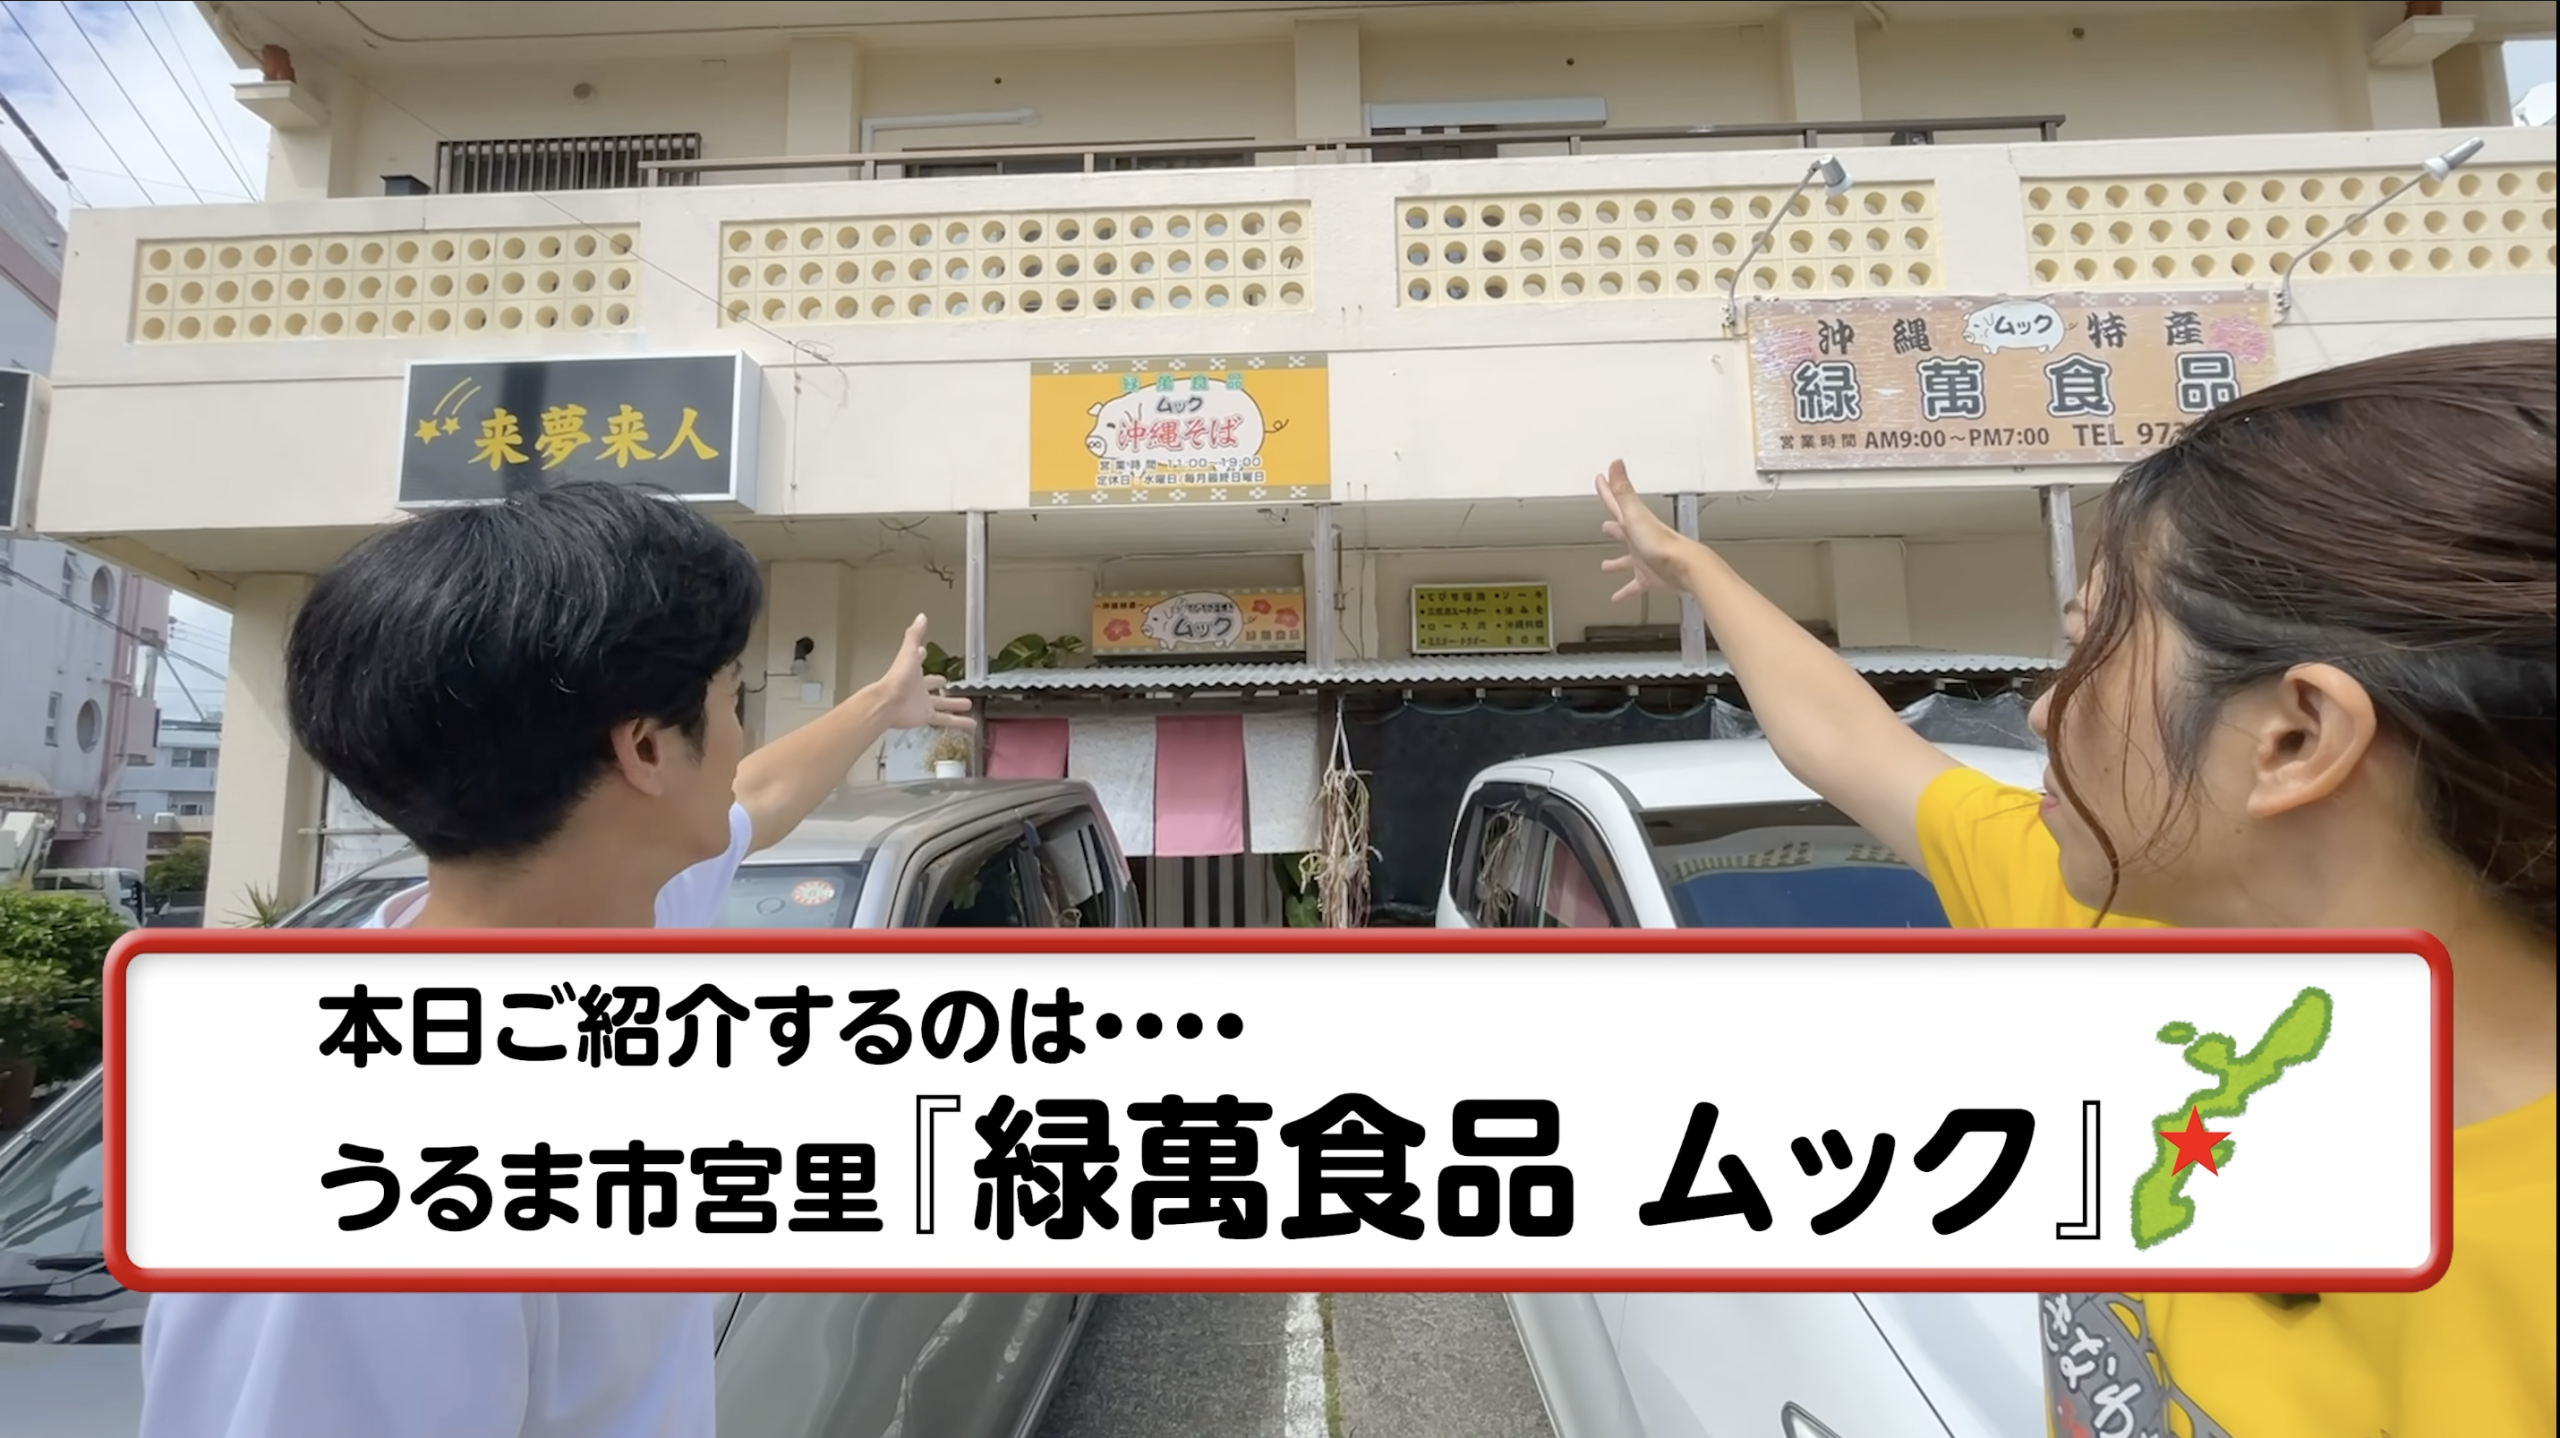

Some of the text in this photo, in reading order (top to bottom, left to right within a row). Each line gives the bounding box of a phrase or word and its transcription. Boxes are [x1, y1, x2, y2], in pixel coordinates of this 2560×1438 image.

[1818, 311, 2204, 354] 沖縄 ムック 特産
[1156, 396, 1203, 413] ムック
[1791, 352, 2240, 422] 緑萬食品
[467, 403, 720, 471] 来夢来人
[1117, 414, 1244, 452] 沖縄そば
[1780, 433, 1857, 449] 営業時間
[2072, 423, 2124, 446] TEL
[1174, 618, 1231, 637] ムック
